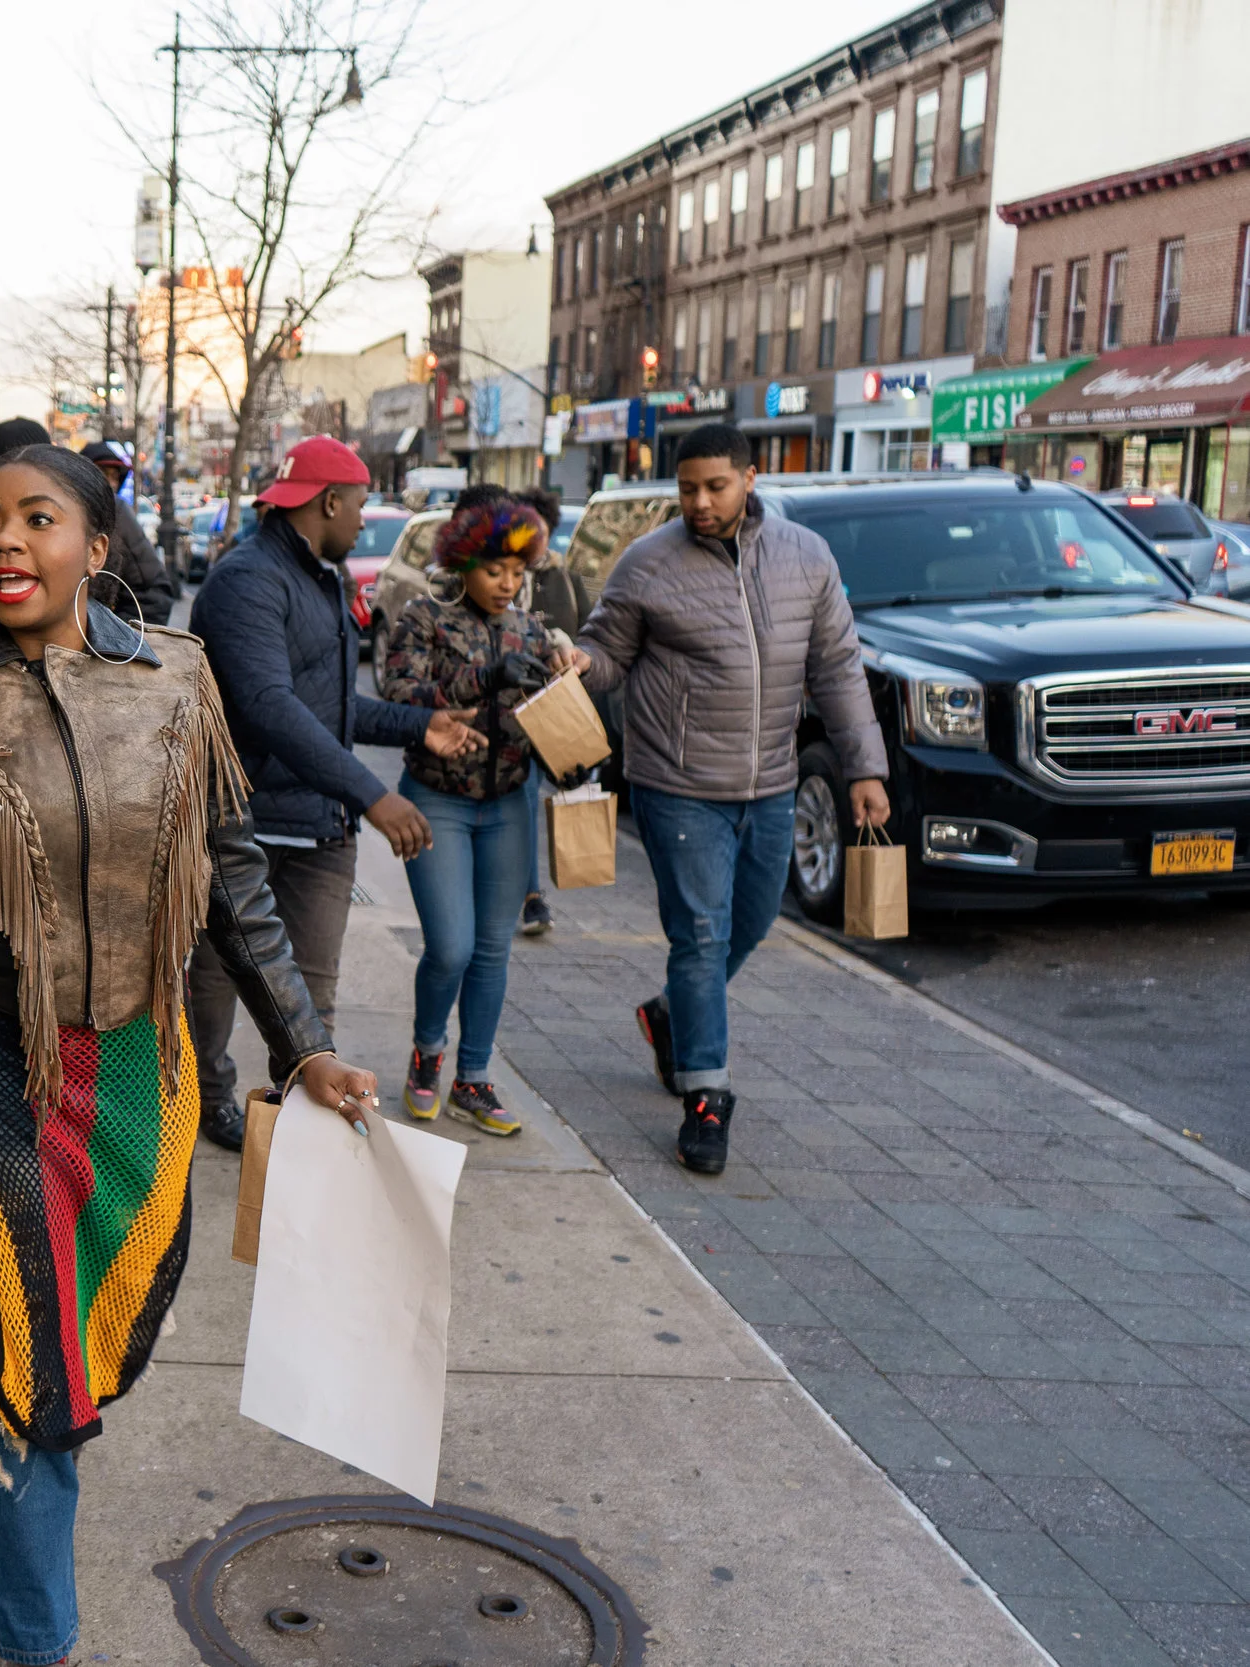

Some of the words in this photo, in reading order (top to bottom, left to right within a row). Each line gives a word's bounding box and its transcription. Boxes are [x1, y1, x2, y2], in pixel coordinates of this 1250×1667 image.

[964, 391, 1026, 430] FISH
[1134, 707, 1237, 734] GMC
[1160, 841, 1227, 865] T630993C
